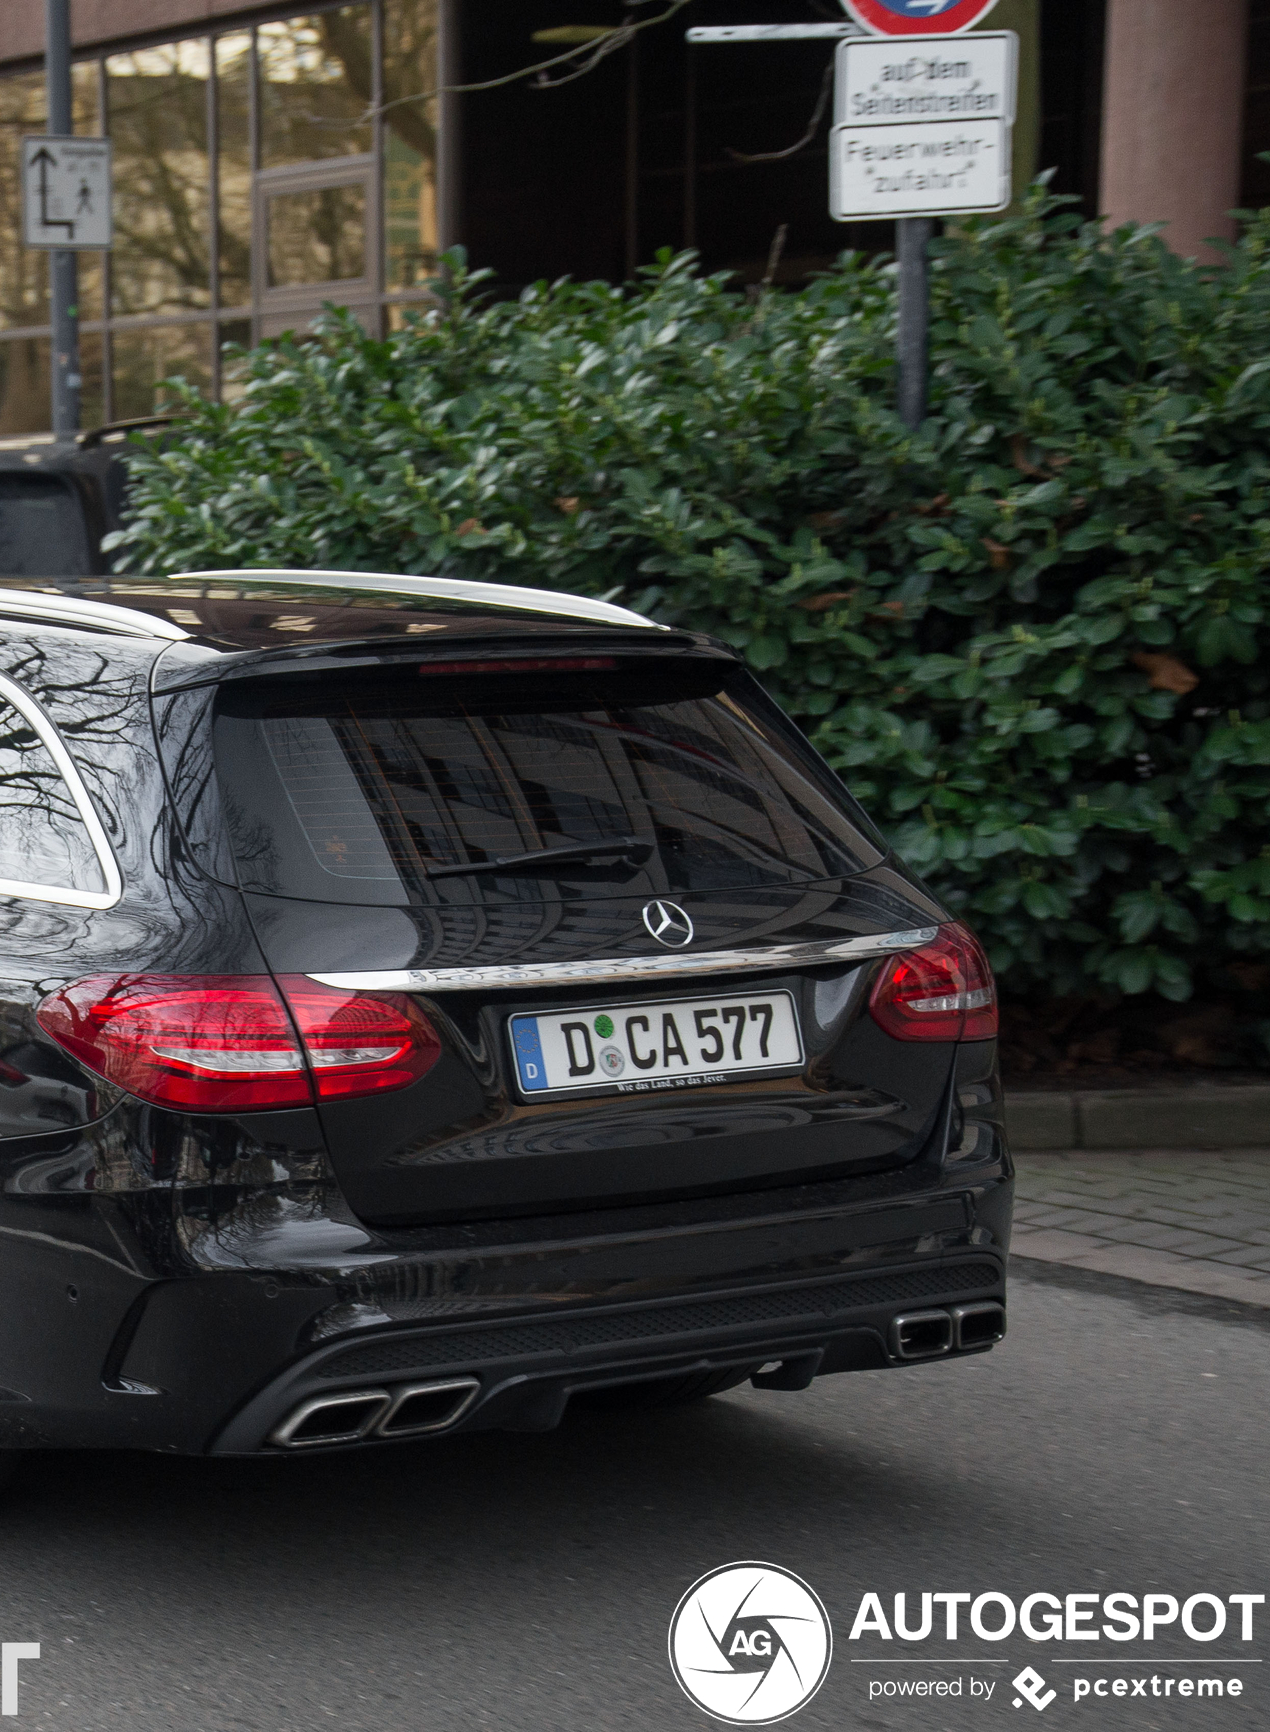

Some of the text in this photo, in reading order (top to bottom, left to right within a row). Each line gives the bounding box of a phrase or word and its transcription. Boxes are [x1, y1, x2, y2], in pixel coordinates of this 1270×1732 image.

[882, 55, 972, 82] auf dem
[851, 90, 998, 116] Seitenstreifen
[845, 135, 997, 163] Feuerwehr-
[560, 1003, 773, 1077] D CA 577
[635, 1081, 649, 1090] das
[651, 1079, 674, 1089] Land,
[687, 1076, 701, 1085] das
